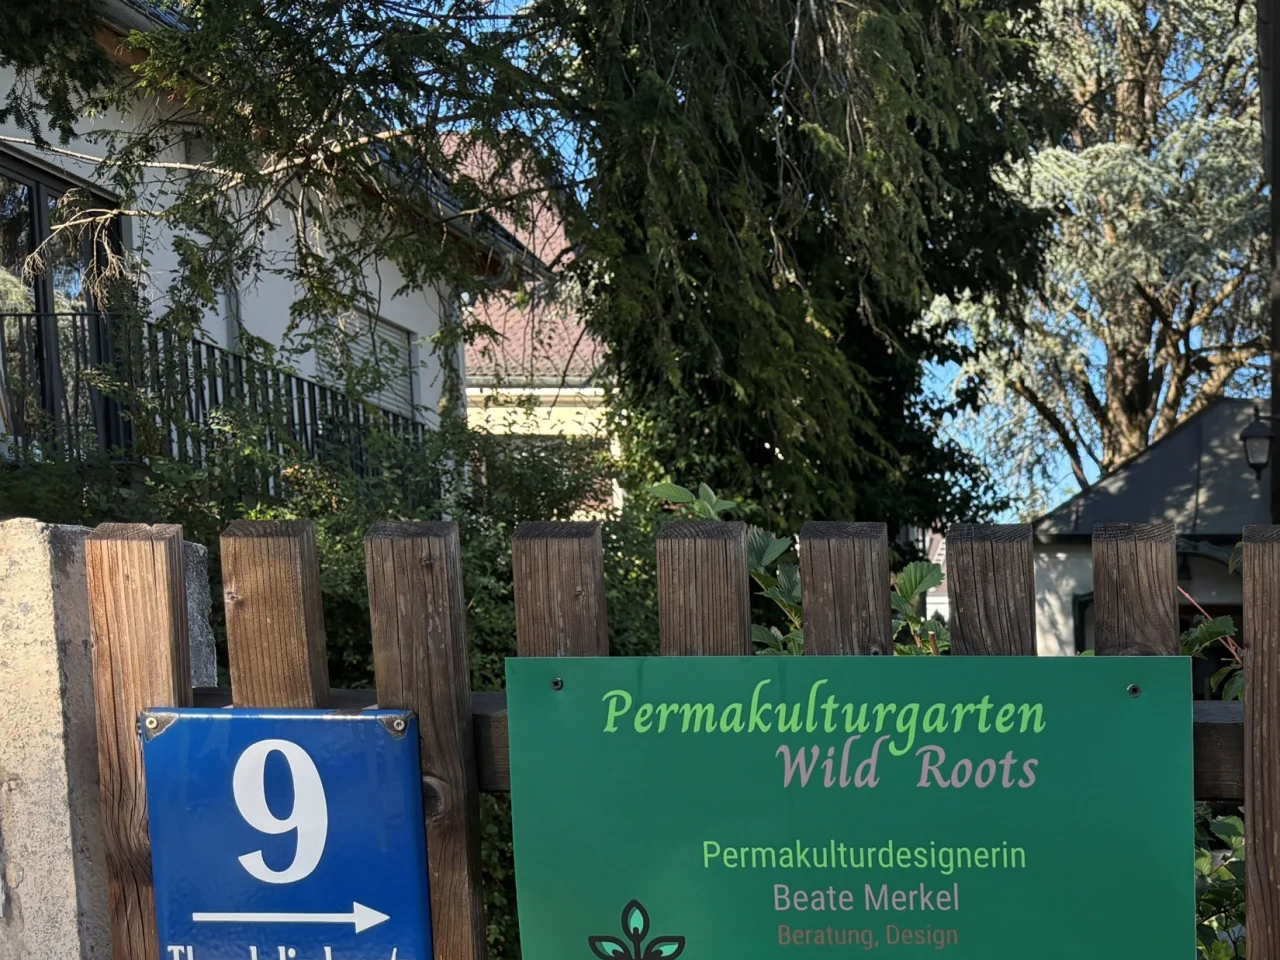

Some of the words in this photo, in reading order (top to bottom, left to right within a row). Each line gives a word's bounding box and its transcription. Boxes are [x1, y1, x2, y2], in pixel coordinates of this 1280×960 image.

[601, 678, 1047, 757] Permakulturgarten
[775, 734, 891, 789] Wild
[915, 744, 1040, 789] Roots
[232, 738, 328, 884] 9
[702, 839, 1027, 875] Permakulturdesignerin
[773, 883, 854, 911] Beate
[864, 882, 960, 911] Merkel
[777, 924, 879, 950] Beratung,
[886, 924, 959, 950] Design
